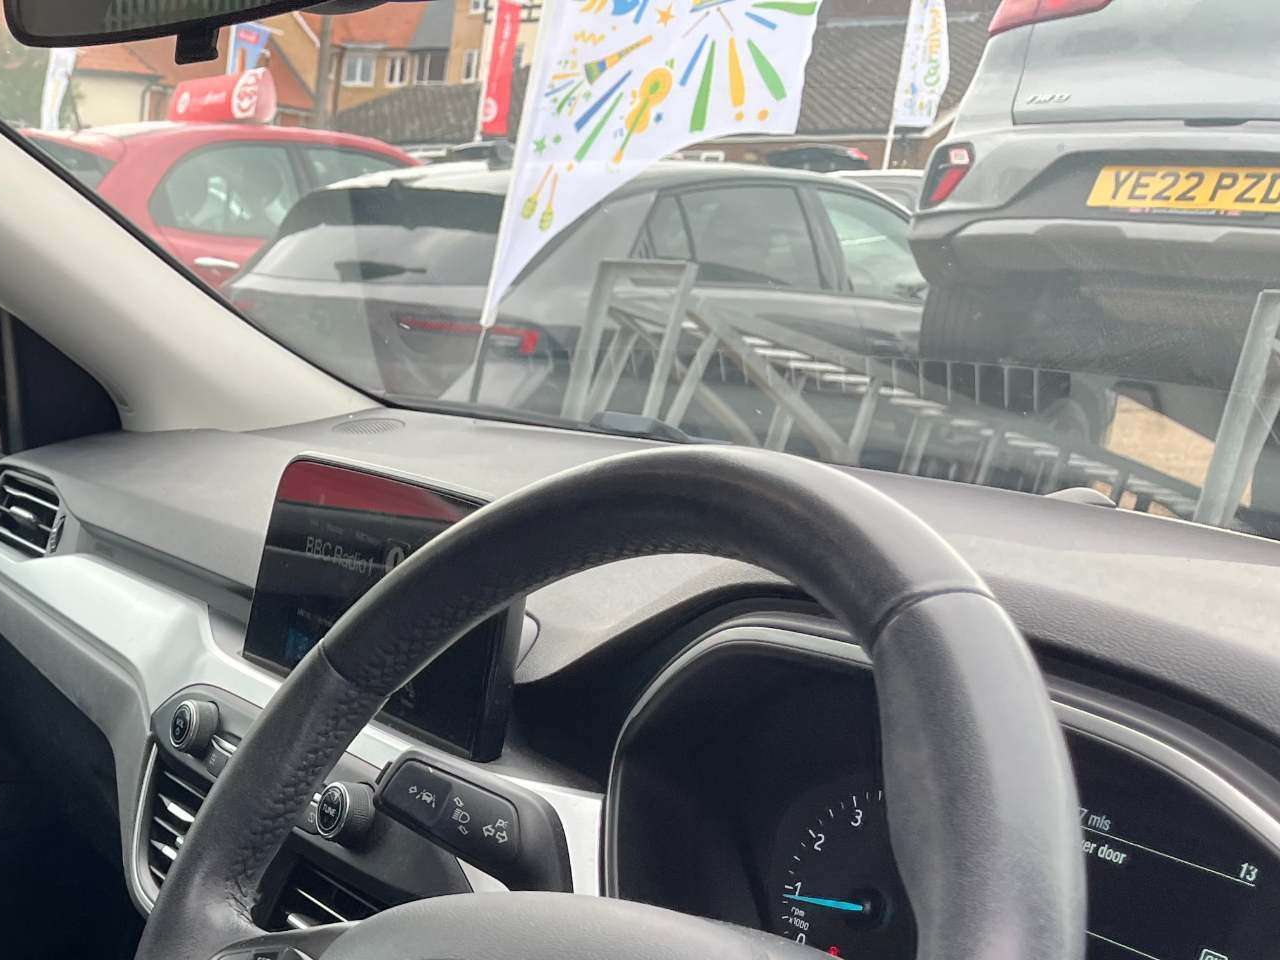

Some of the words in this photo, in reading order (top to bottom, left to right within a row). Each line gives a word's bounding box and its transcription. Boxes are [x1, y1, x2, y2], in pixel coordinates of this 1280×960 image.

[1111, 171, 1206, 201] YE22
[322, 804, 337, 818] TUNE
[851, 809, 863, 827] 3
[1088, 814, 1111, 831] mls
[814, 833, 825, 852] 2
[1098, 844, 1127, 864] door
[1239, 862, 1259, 882] 13
[793, 881, 802, 897] 1
[790, 906, 805, 918] rpm
[788, 917, 810, 932] x1000
